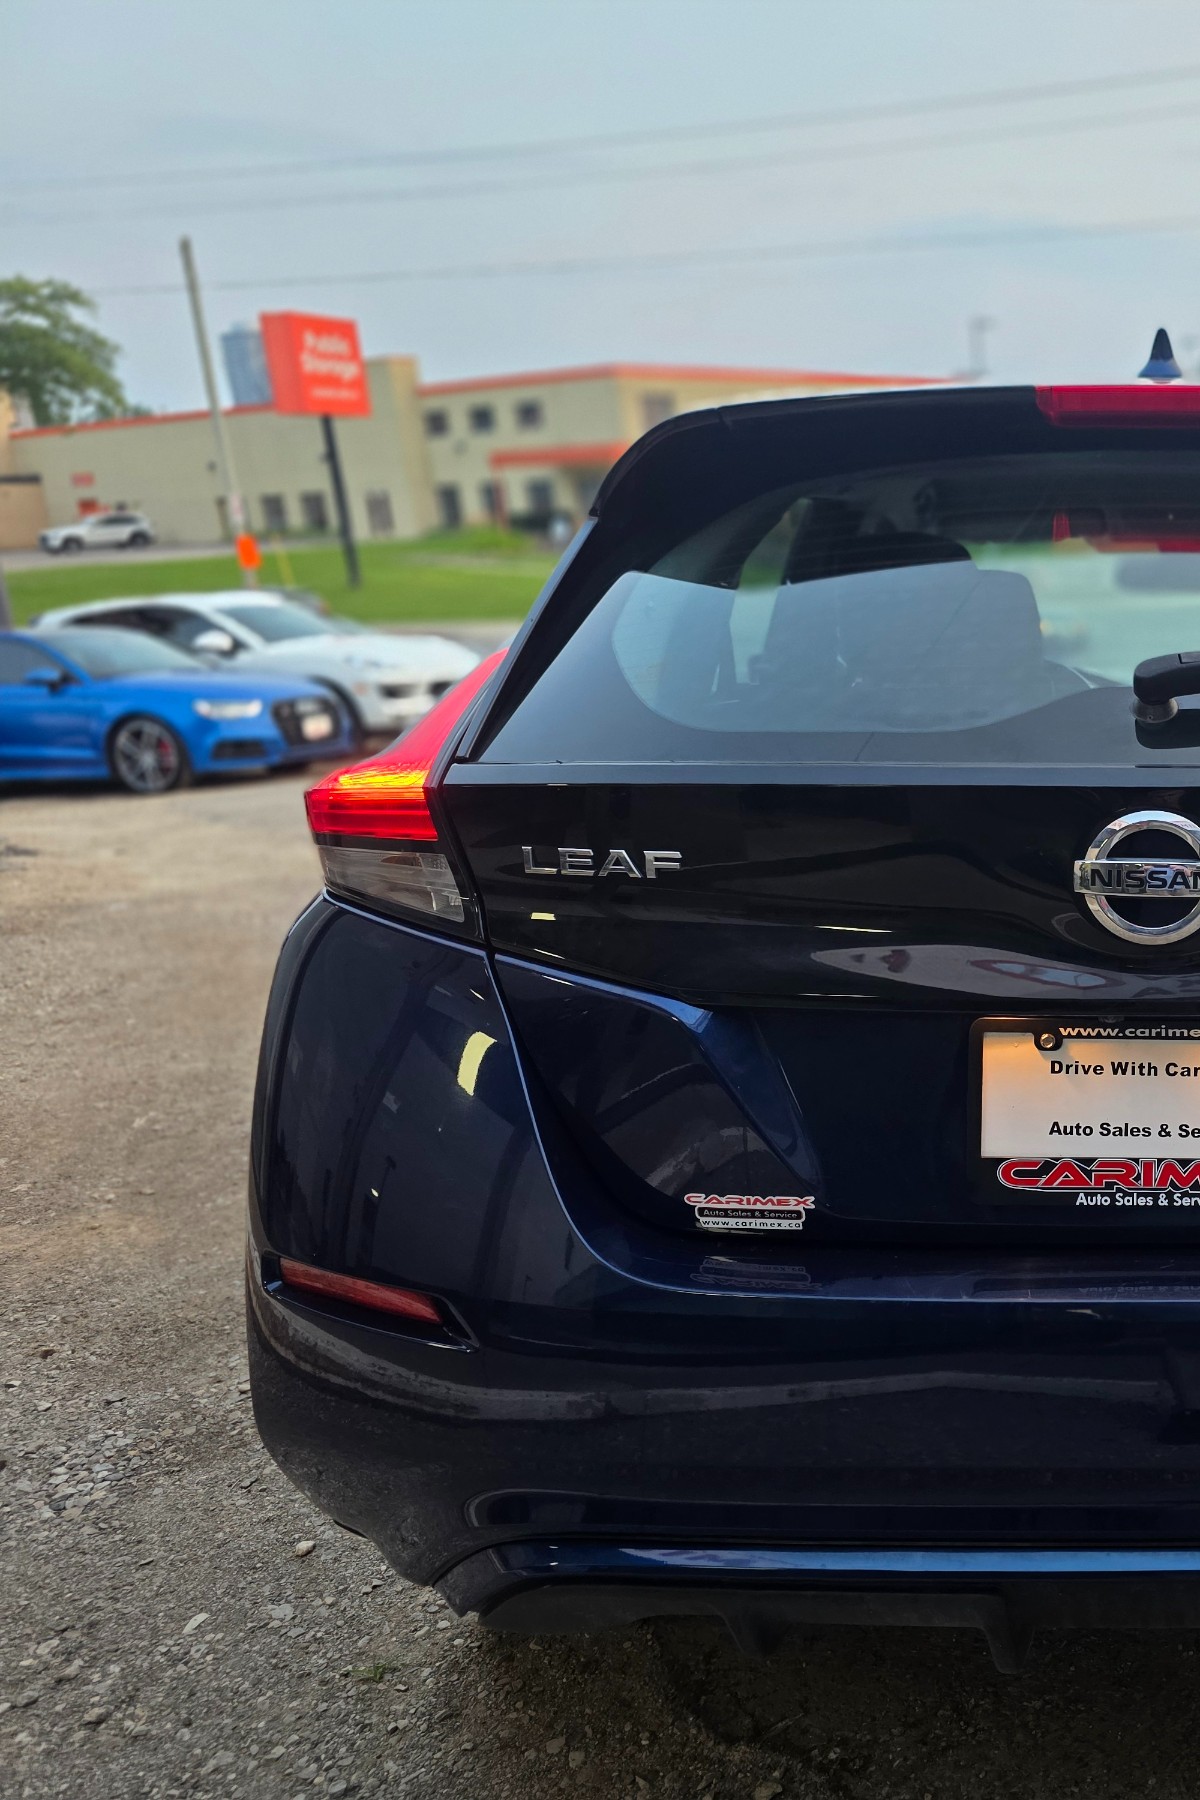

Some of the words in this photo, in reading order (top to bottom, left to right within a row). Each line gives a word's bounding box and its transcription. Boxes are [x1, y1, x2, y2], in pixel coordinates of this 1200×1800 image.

[522, 846, 682, 878] LEAF
[1050, 1061, 1105, 1076] Drive
[1111, 1062, 1158, 1077] With
[1049, 1121, 1094, 1137] Auto
[1099, 1122, 1151, 1138] Sales
[1158, 1123, 1172, 1138] &
[685, 1193, 815, 1208] CARIMEX
[1076, 1192, 1112, 1206] Auto
[1115, 1193, 1153, 1207] Sales
[1158, 1194, 1169, 1206] &
[727, 1209, 752, 1217] Sales
[764, 1210, 798, 1218] Service
[701, 1219, 801, 1228] www.carimex.ca
